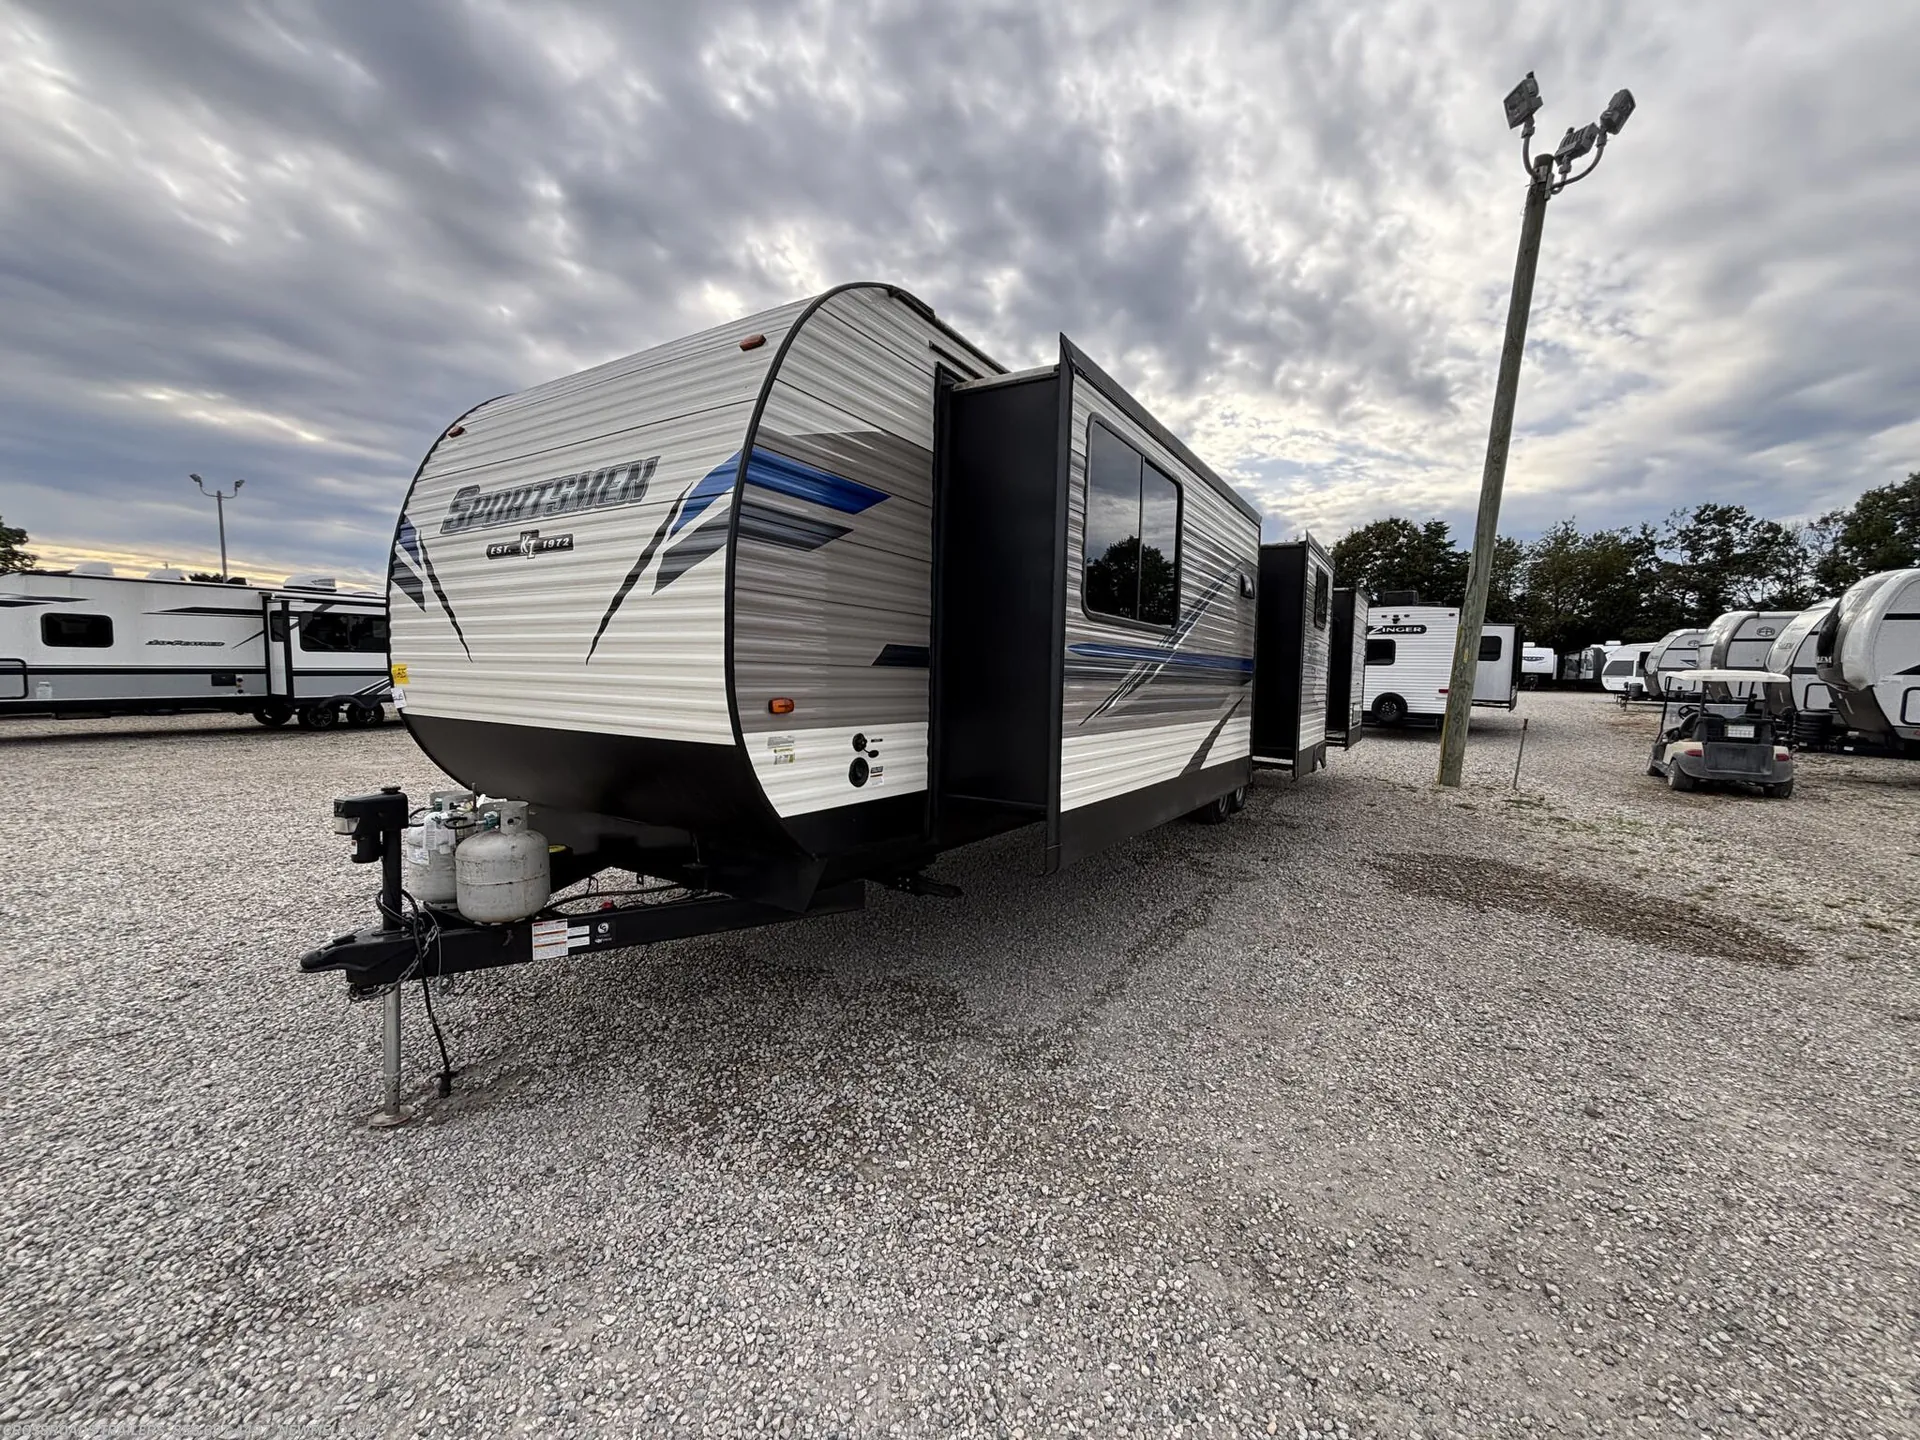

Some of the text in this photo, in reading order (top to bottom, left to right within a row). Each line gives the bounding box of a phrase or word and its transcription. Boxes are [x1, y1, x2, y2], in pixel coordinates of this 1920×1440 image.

[440, 455, 661, 534] SPORTSMEN
[490, 544, 511, 556] EST.
[542, 537, 571, 549] 1972
[1368, 625, 1423, 636] ZINGER
